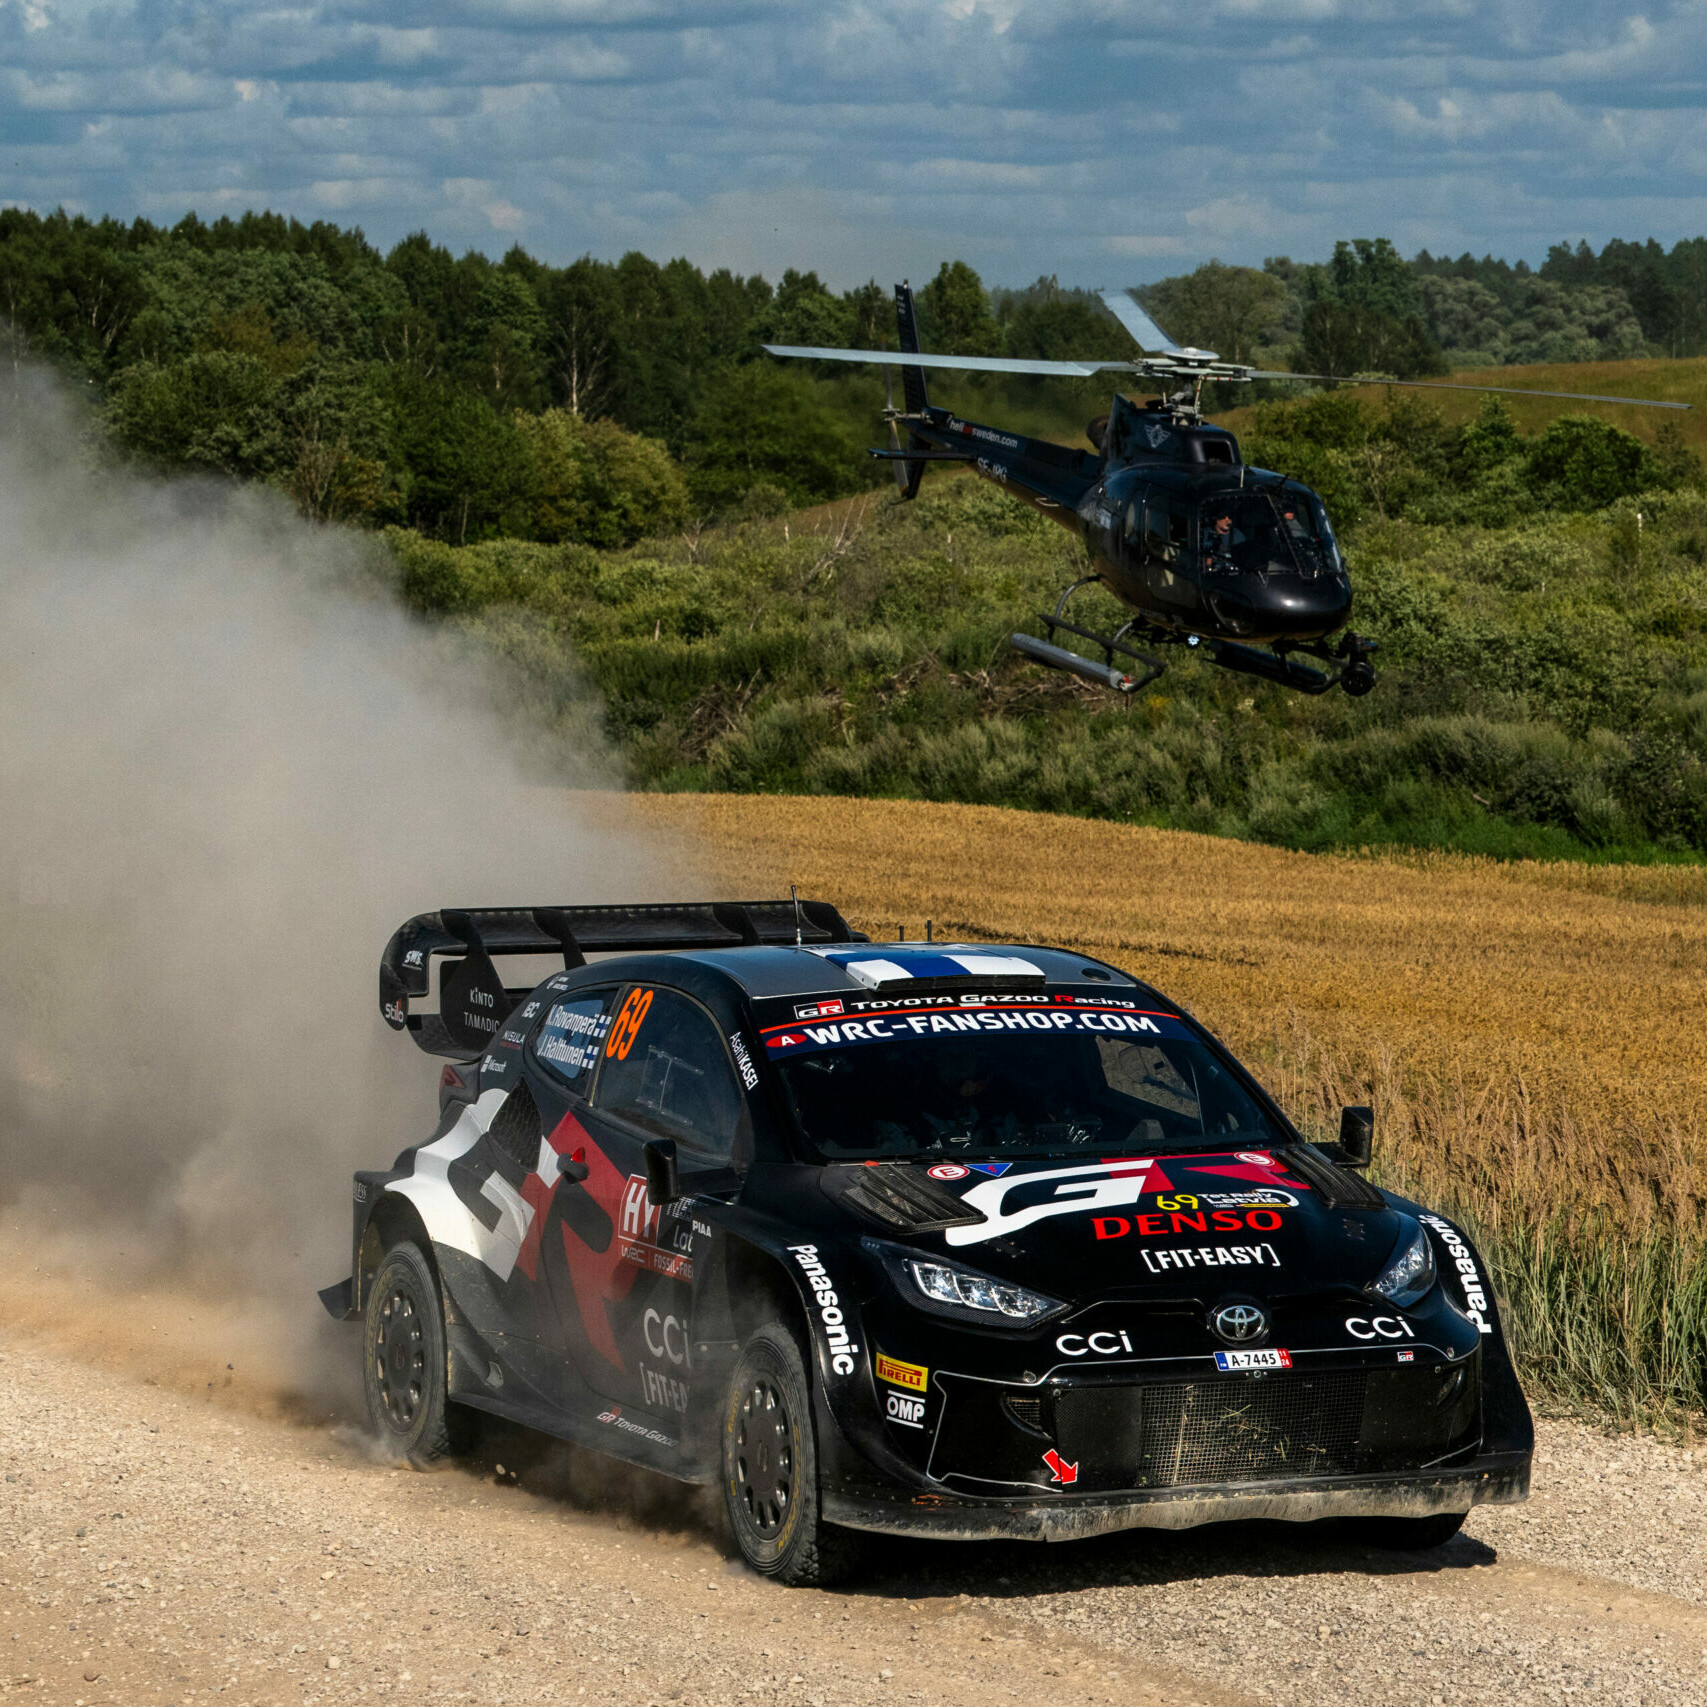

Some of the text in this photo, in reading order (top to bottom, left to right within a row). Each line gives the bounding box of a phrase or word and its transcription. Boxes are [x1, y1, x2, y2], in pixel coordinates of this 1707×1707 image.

[385, 998, 404, 1023] Stilo
[850, 994, 1136, 1010] TOYOTA GAZOO Racing
[463, 1011, 500, 1032] TAMADIC
[606, 987, 654, 1061] 69
[803, 1012, 1162, 1045] WRC-FANSHOP.COM
[780, 1035, 796, 1046] A
[1156, 1194, 1199, 1211] 69
[692, 1219, 712, 1238] PIAA
[1091, 1209, 1283, 1241] DENSO
[653, 1253, 694, 1279] FOSSIL-FRE
[1418, 1213, 1492, 1334] Panasonic
[787, 1243, 859, 1376] Panasonic
[878, 1358, 923, 1387] PIRELLI
[1231, 1353, 1277, 1367] A-7445
[886, 1396, 926, 1422] OMP
[614, 1416, 648, 1436] TOYOTA
